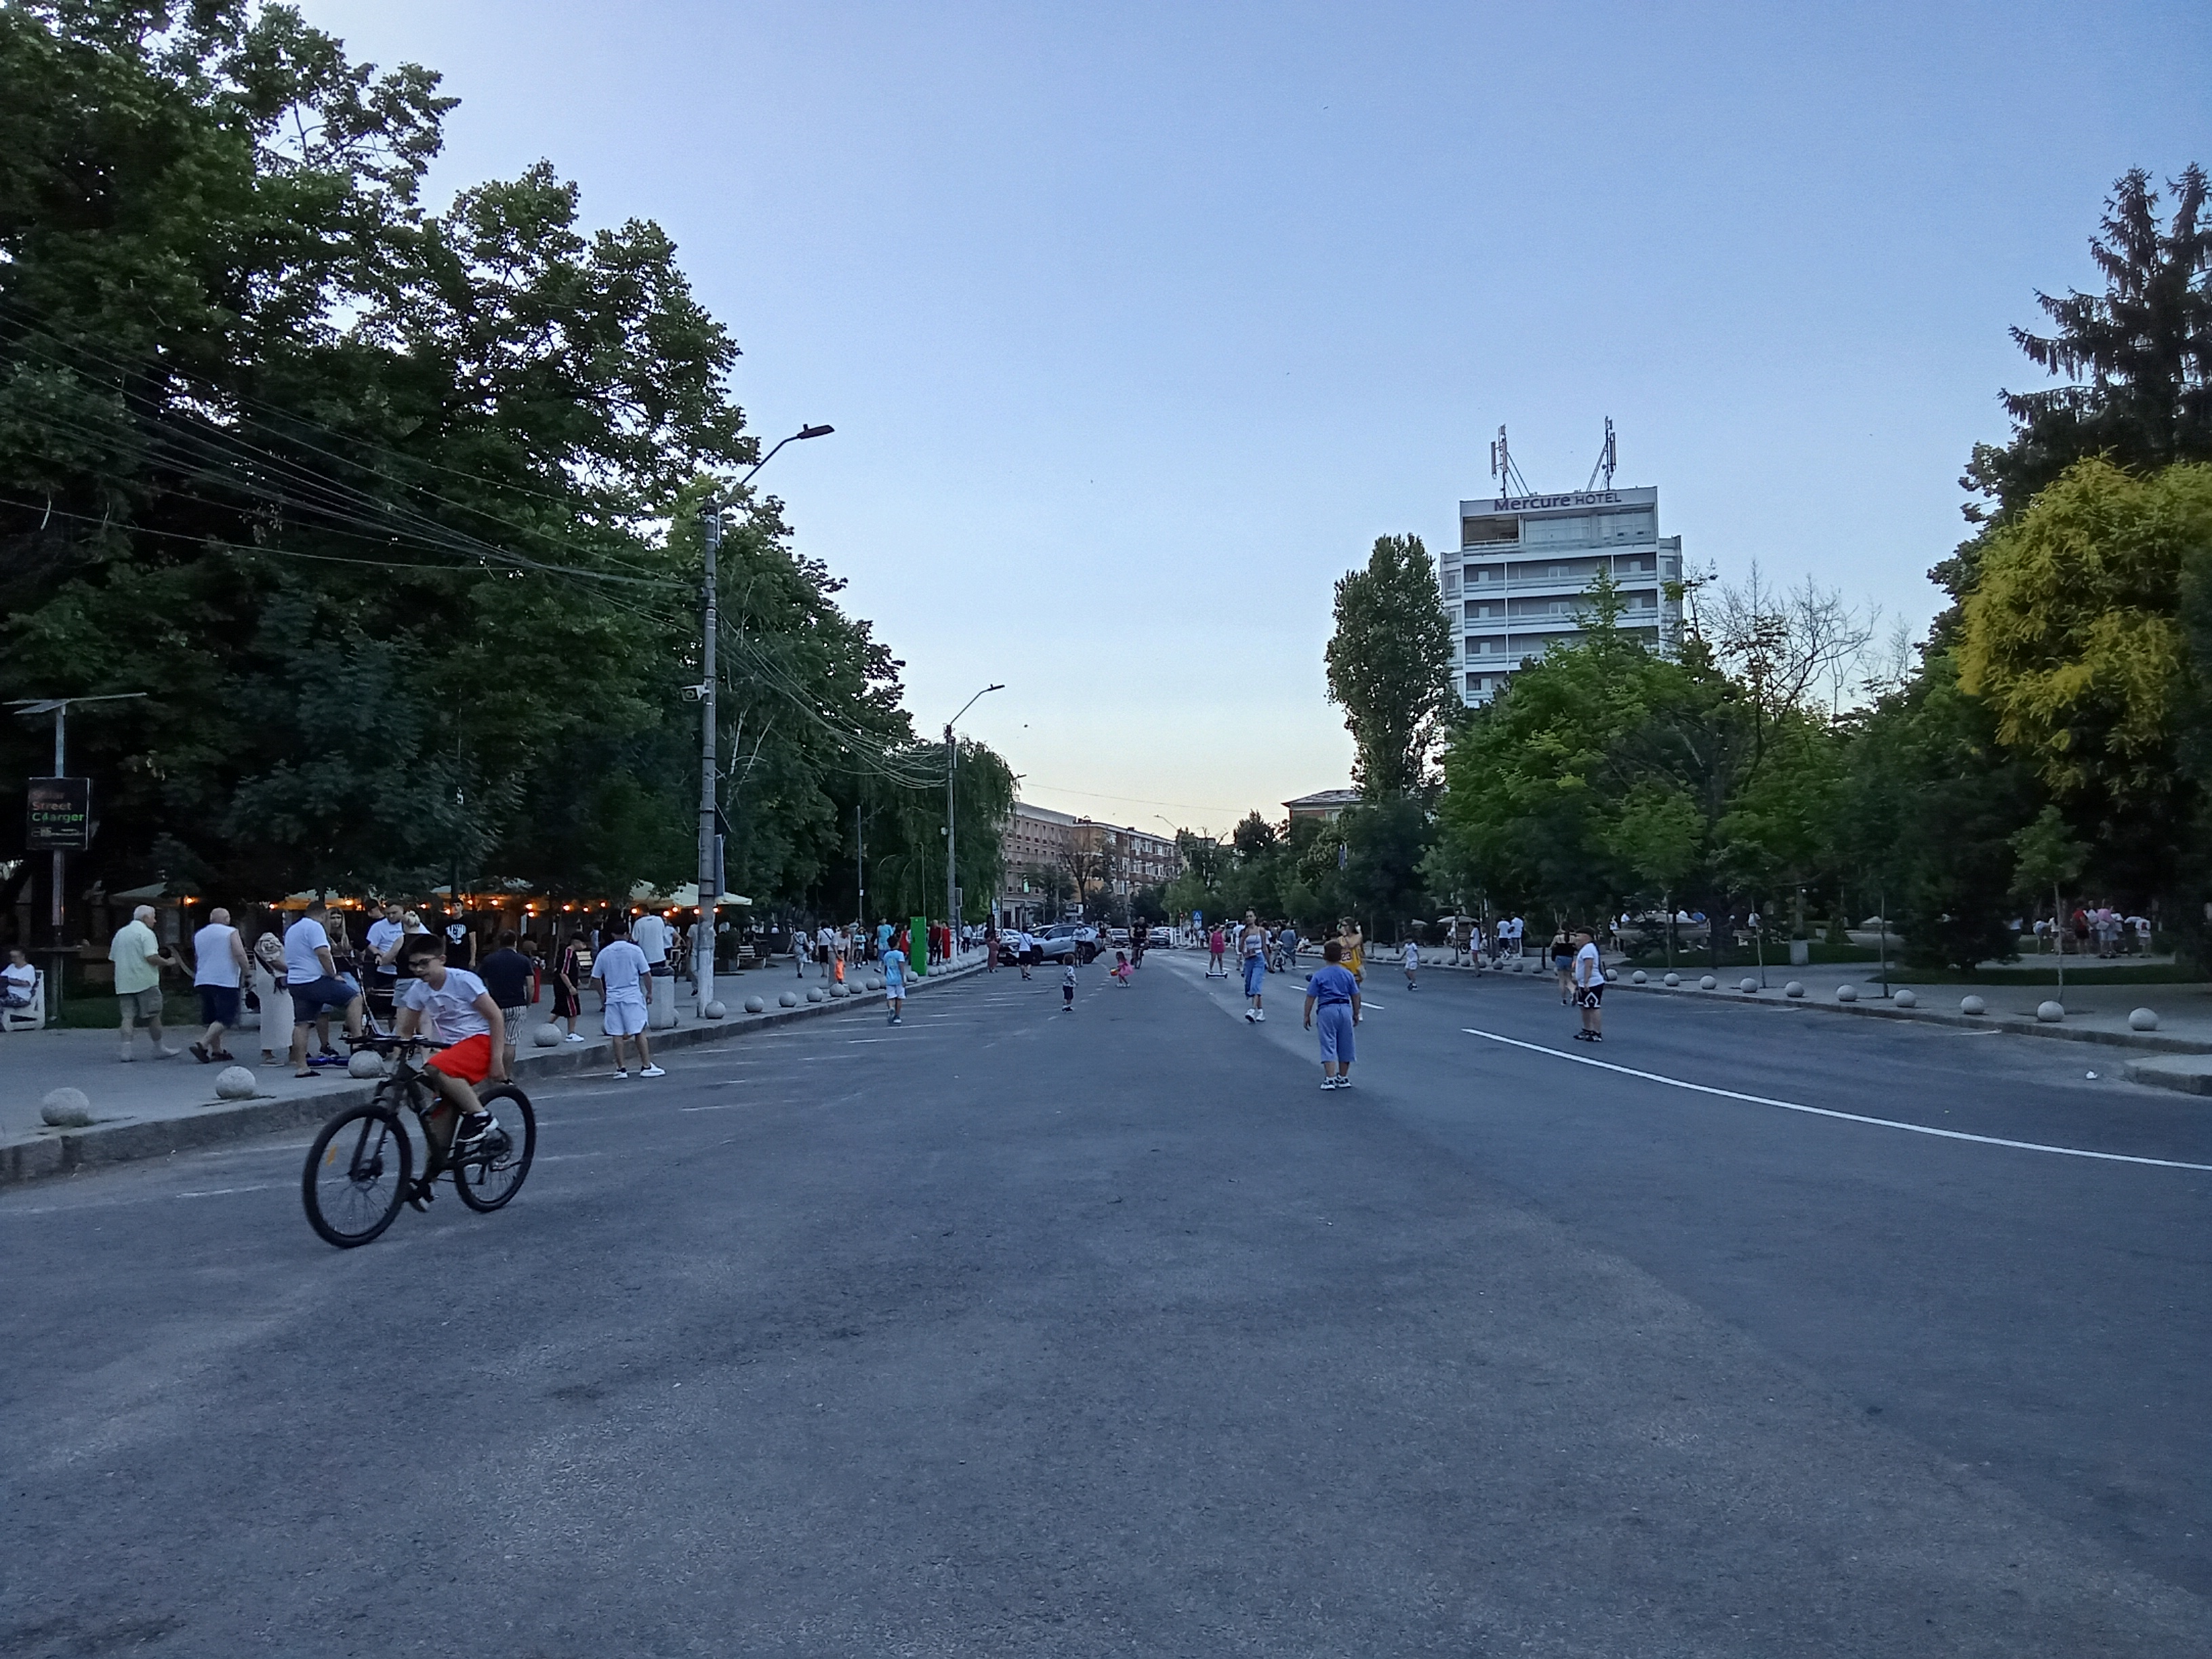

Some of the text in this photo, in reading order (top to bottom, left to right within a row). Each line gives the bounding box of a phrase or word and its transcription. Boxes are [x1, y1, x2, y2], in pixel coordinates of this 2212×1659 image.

[1494, 493, 1622, 511] Mercure HOTEL
[32, 801, 72, 811] Street
